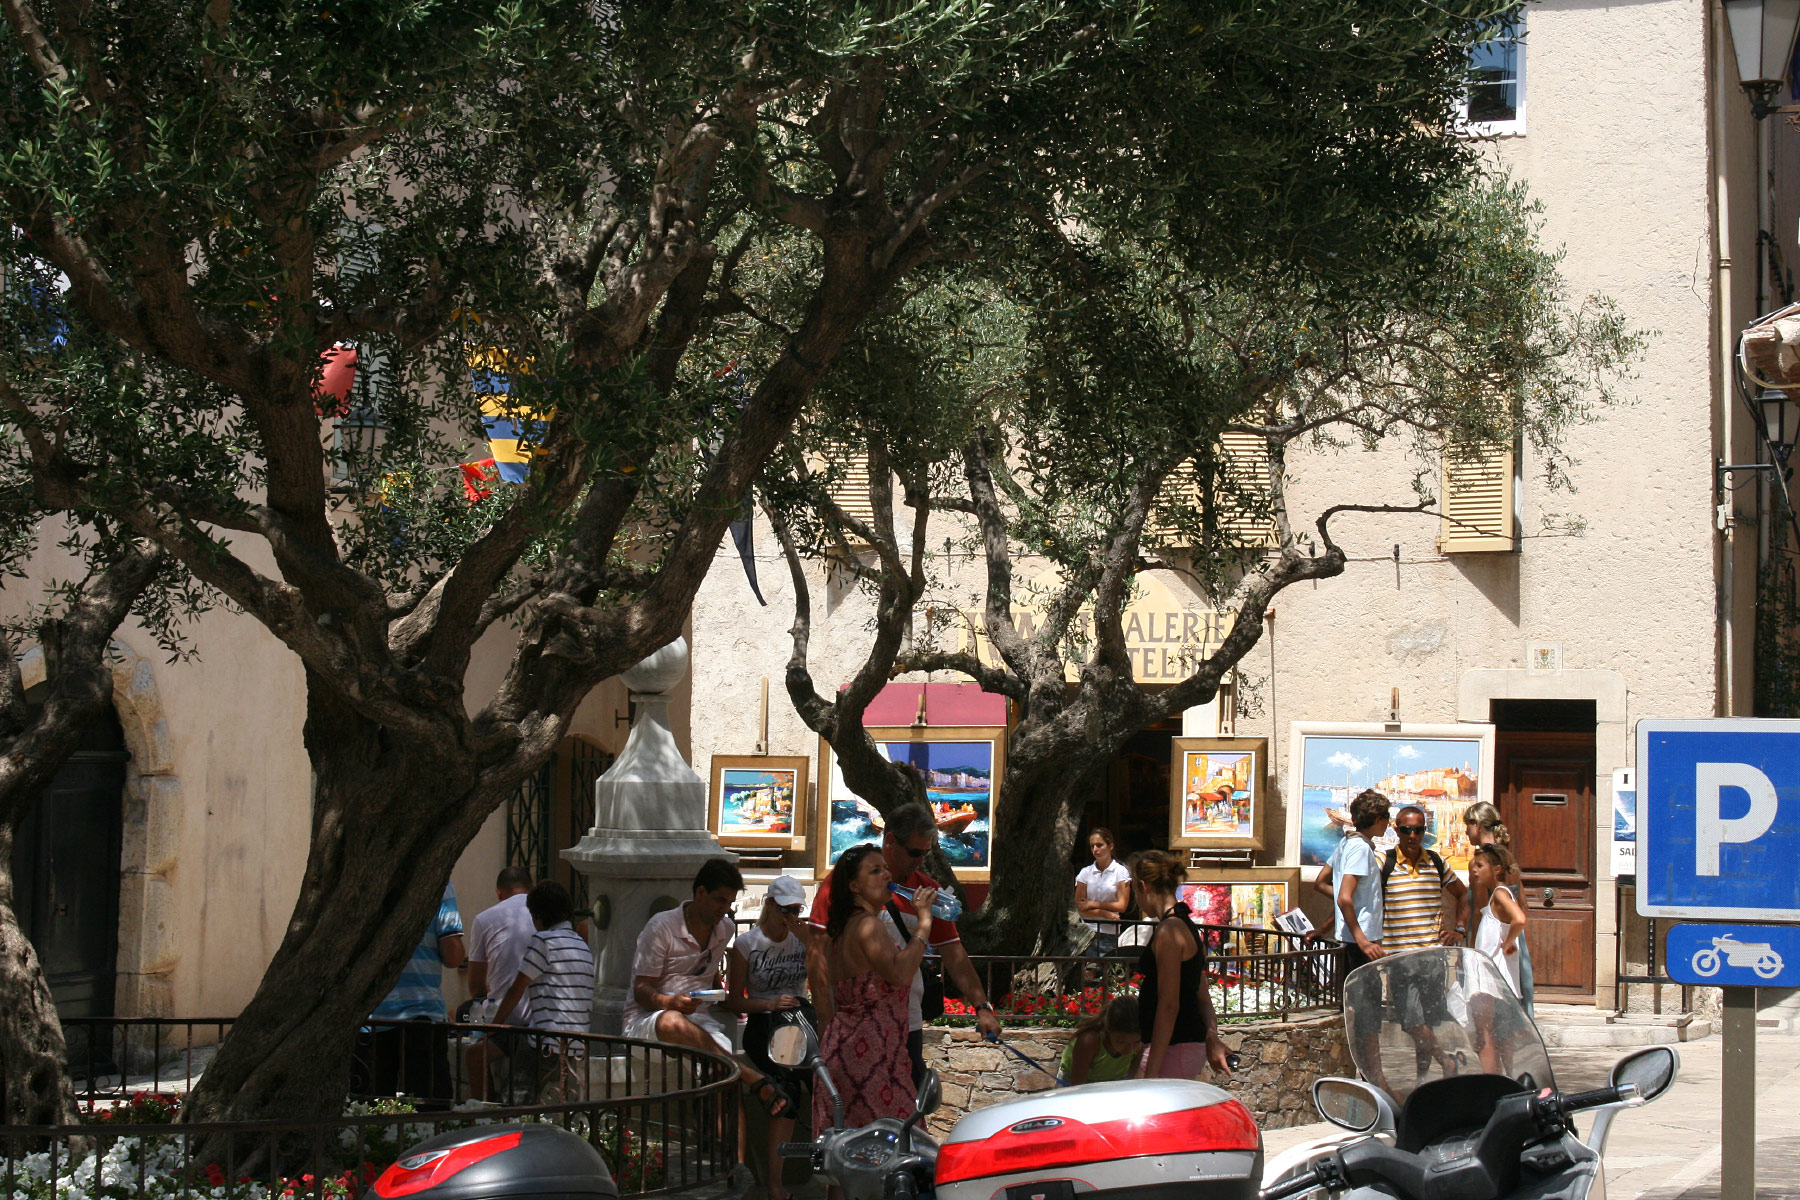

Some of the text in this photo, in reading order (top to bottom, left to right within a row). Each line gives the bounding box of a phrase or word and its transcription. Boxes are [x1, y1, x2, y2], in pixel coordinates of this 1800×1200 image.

[1124, 612, 1227, 643] ALERIE
[1127, 647, 1232, 679] TELIE
[1695, 762, 1778, 876] P
[1015, 1119, 1059, 1130] SHAD
